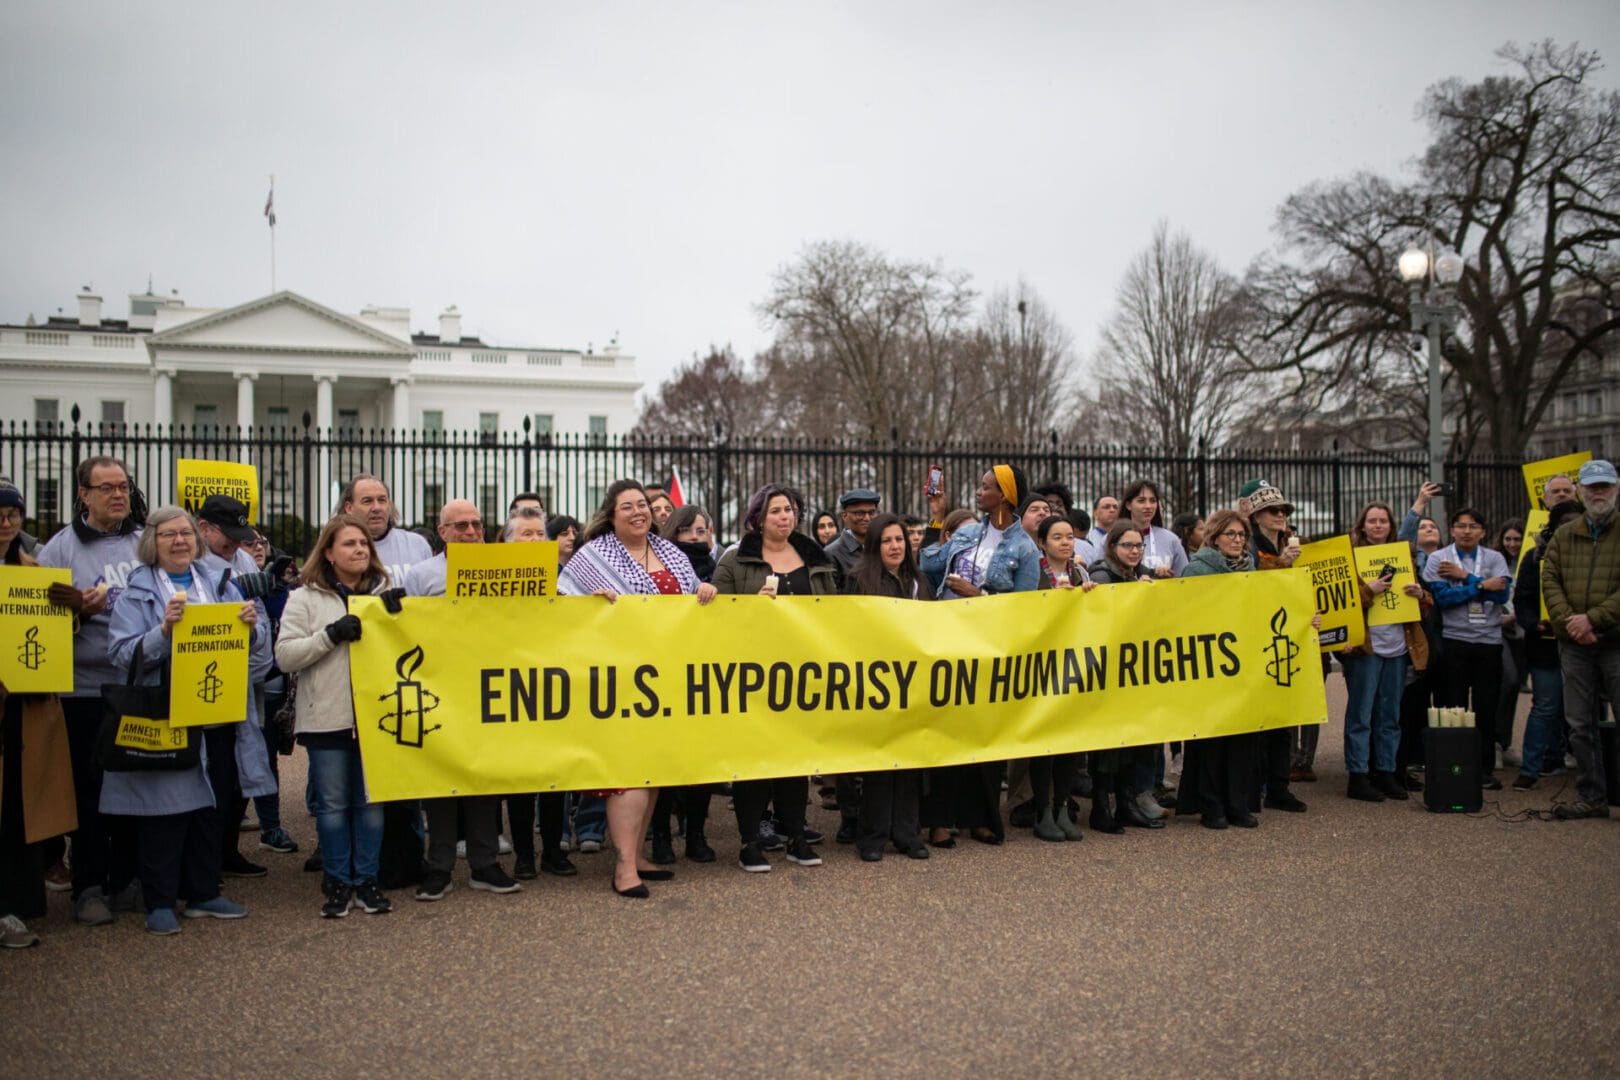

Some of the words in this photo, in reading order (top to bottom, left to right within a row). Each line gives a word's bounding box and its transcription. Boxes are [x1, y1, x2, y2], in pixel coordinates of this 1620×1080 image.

[185, 475, 225, 486] PRESIDENT
[185, 485, 251, 500] CEASEFIRE
[457, 568, 513, 580] PRESIDENT
[1312, 565, 1351, 587] ASEFIRE
[8, 586, 49, 600] AMNEST
[456, 580, 547, 597] CEASEFIRE
[1316, 580, 1356, 615] OW!
[0, 603, 68, 617] NTERNATIONAL
[191, 624, 233, 637] AMNESTY
[177, 639, 245, 654] INTERNATIONAL
[480, 667, 571, 724] END
[589, 664, 671, 719] U.S.
[686, 660, 918, 716] HYPOCRISY
[929, 658, 979, 707] ON
[988, 645, 1107, 703] HUMAN
[1118, 631, 1241, 688] RIGHTS
